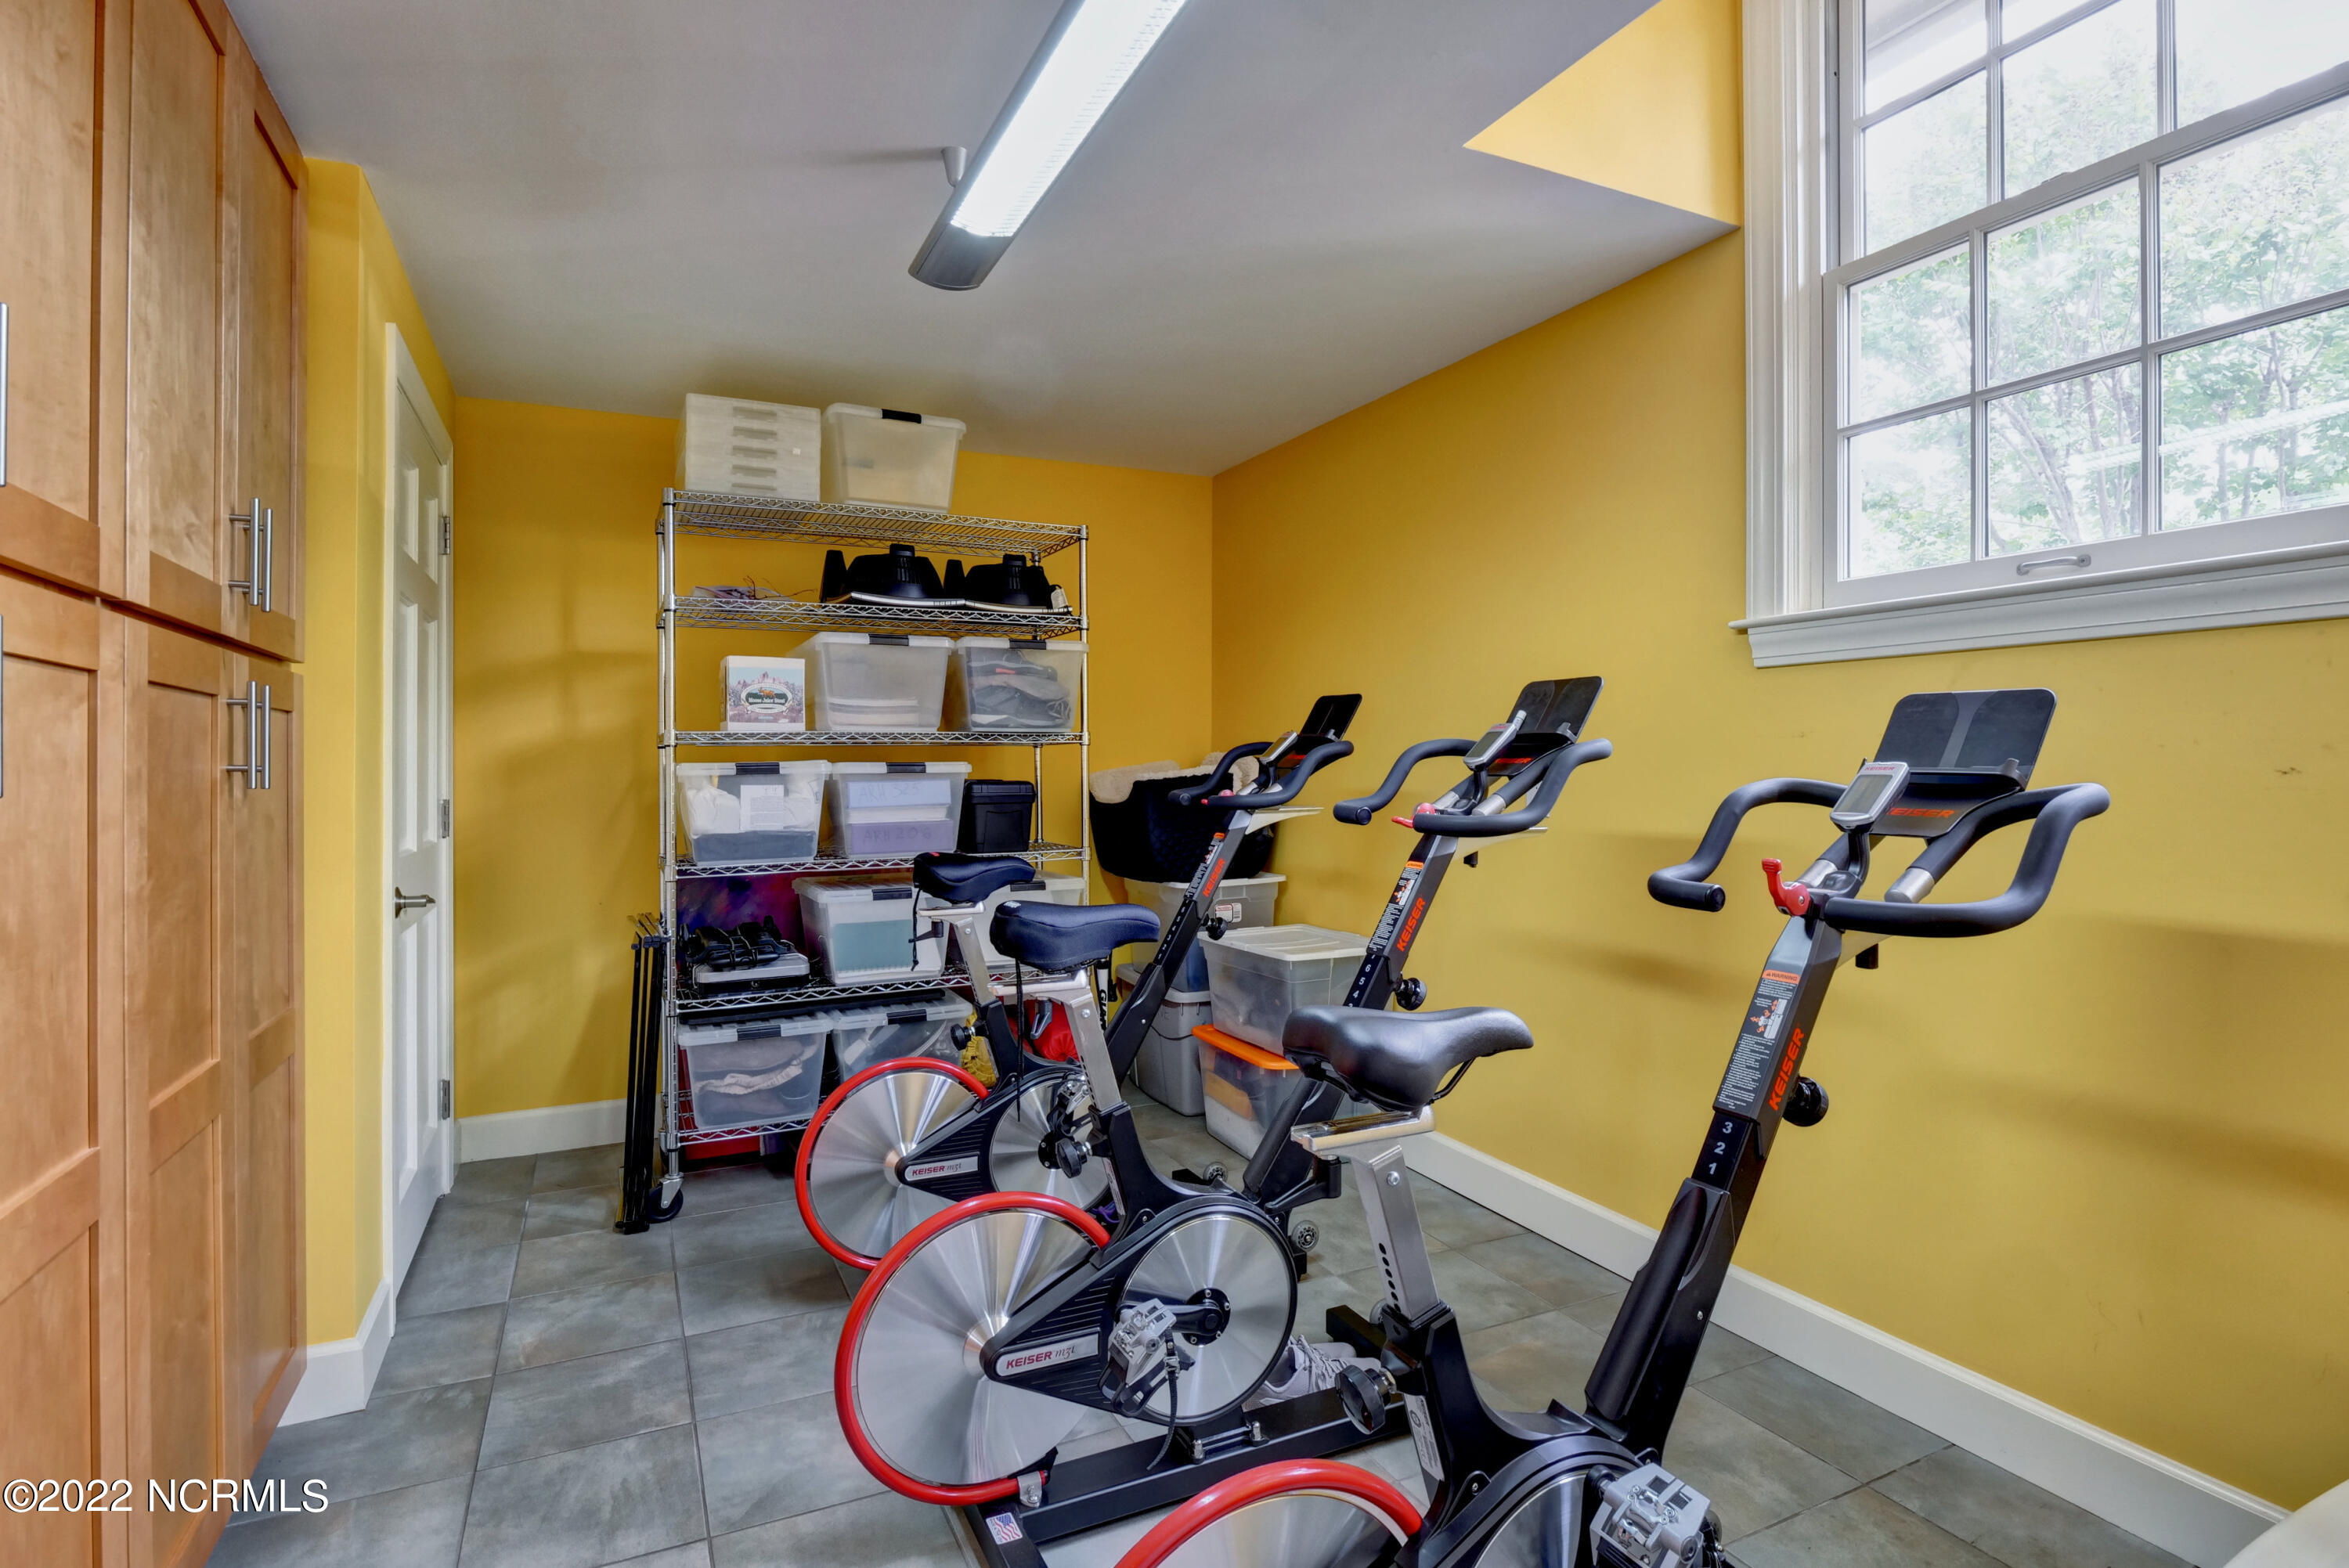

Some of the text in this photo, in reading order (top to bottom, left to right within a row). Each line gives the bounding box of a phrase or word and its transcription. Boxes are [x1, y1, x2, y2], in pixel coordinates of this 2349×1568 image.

[1202, 857, 1225, 898] KEISER
[1396, 897, 1426, 952] KEISER
[1365, 964, 1372, 972] 6
[1771, 972, 1798, 982] WARNING
[1352, 989, 1359, 998] 4
[1767, 1027, 1805, 1111] KEISER
[1723, 1121, 1733, 1134] 3
[1714, 1141, 1726, 1155] 2
[912, 1165, 945, 1177] KEISER
[1709, 1162, 1717, 1175] 1
[1006, 1351, 1052, 1369] KEISER
